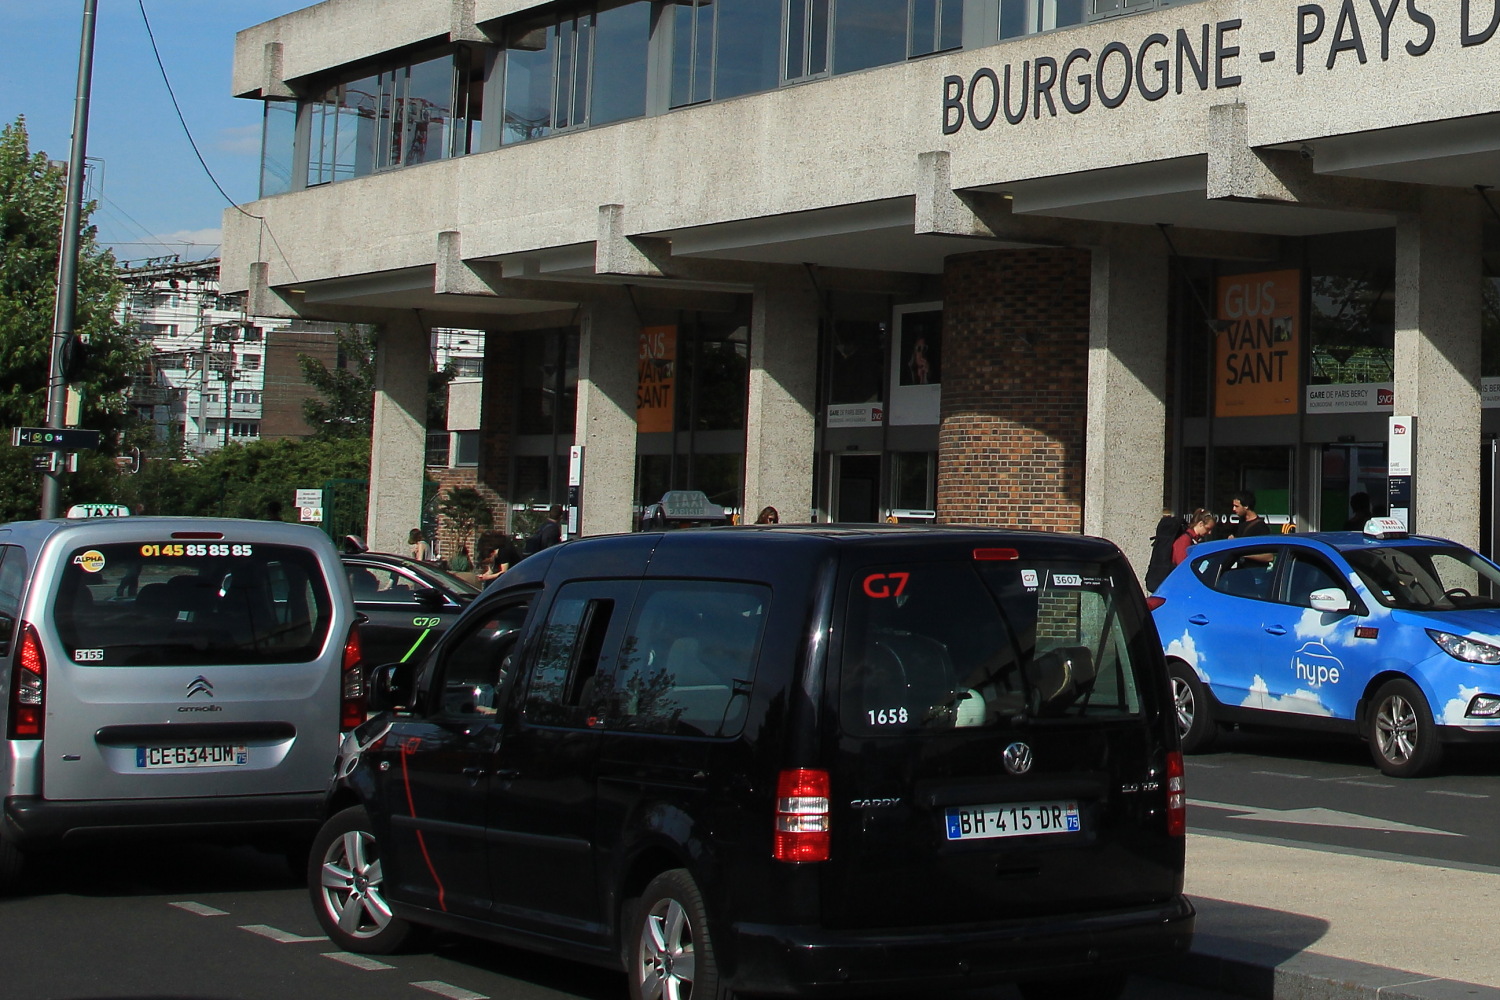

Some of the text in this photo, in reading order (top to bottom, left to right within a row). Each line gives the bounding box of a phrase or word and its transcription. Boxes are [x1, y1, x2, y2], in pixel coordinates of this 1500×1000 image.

[941, 17, 1242, 136] BOURGOGNE
[1258, 52, 1277, 62] -
[1225, 281, 1275, 318] GUS
[1227, 317, 1274, 351] VAN
[1226, 350, 1289, 386] SANT
[637, 384, 671, 409] SANT
[1309, 389, 1368, 399] GARE DE PARIS BERCY
[673, 493, 705, 508] TAXI
[84, 507, 120, 517] TAXI
[141, 545, 252, 557] 01 45 85 85 85
[74, 556, 104, 564] ALPHA
[863, 572, 910, 598] G7
[1024, 574, 1035, 582] G7
[1055, 576, 1078, 585] 3607
[413, 617, 429, 627] G7
[75, 650, 104, 660] 5155
[1296, 657, 1340, 686] hype
[177, 705, 223, 713] CITROËN
[868, 707, 909, 725] 1658
[149, 745, 234, 766] CE-634-DM
[237, 754, 247, 764] 75
[851, 797, 900, 808] CADDY
[960, 806, 1062, 835] BH-415-DR
[1067, 816, 1079, 829] 75
